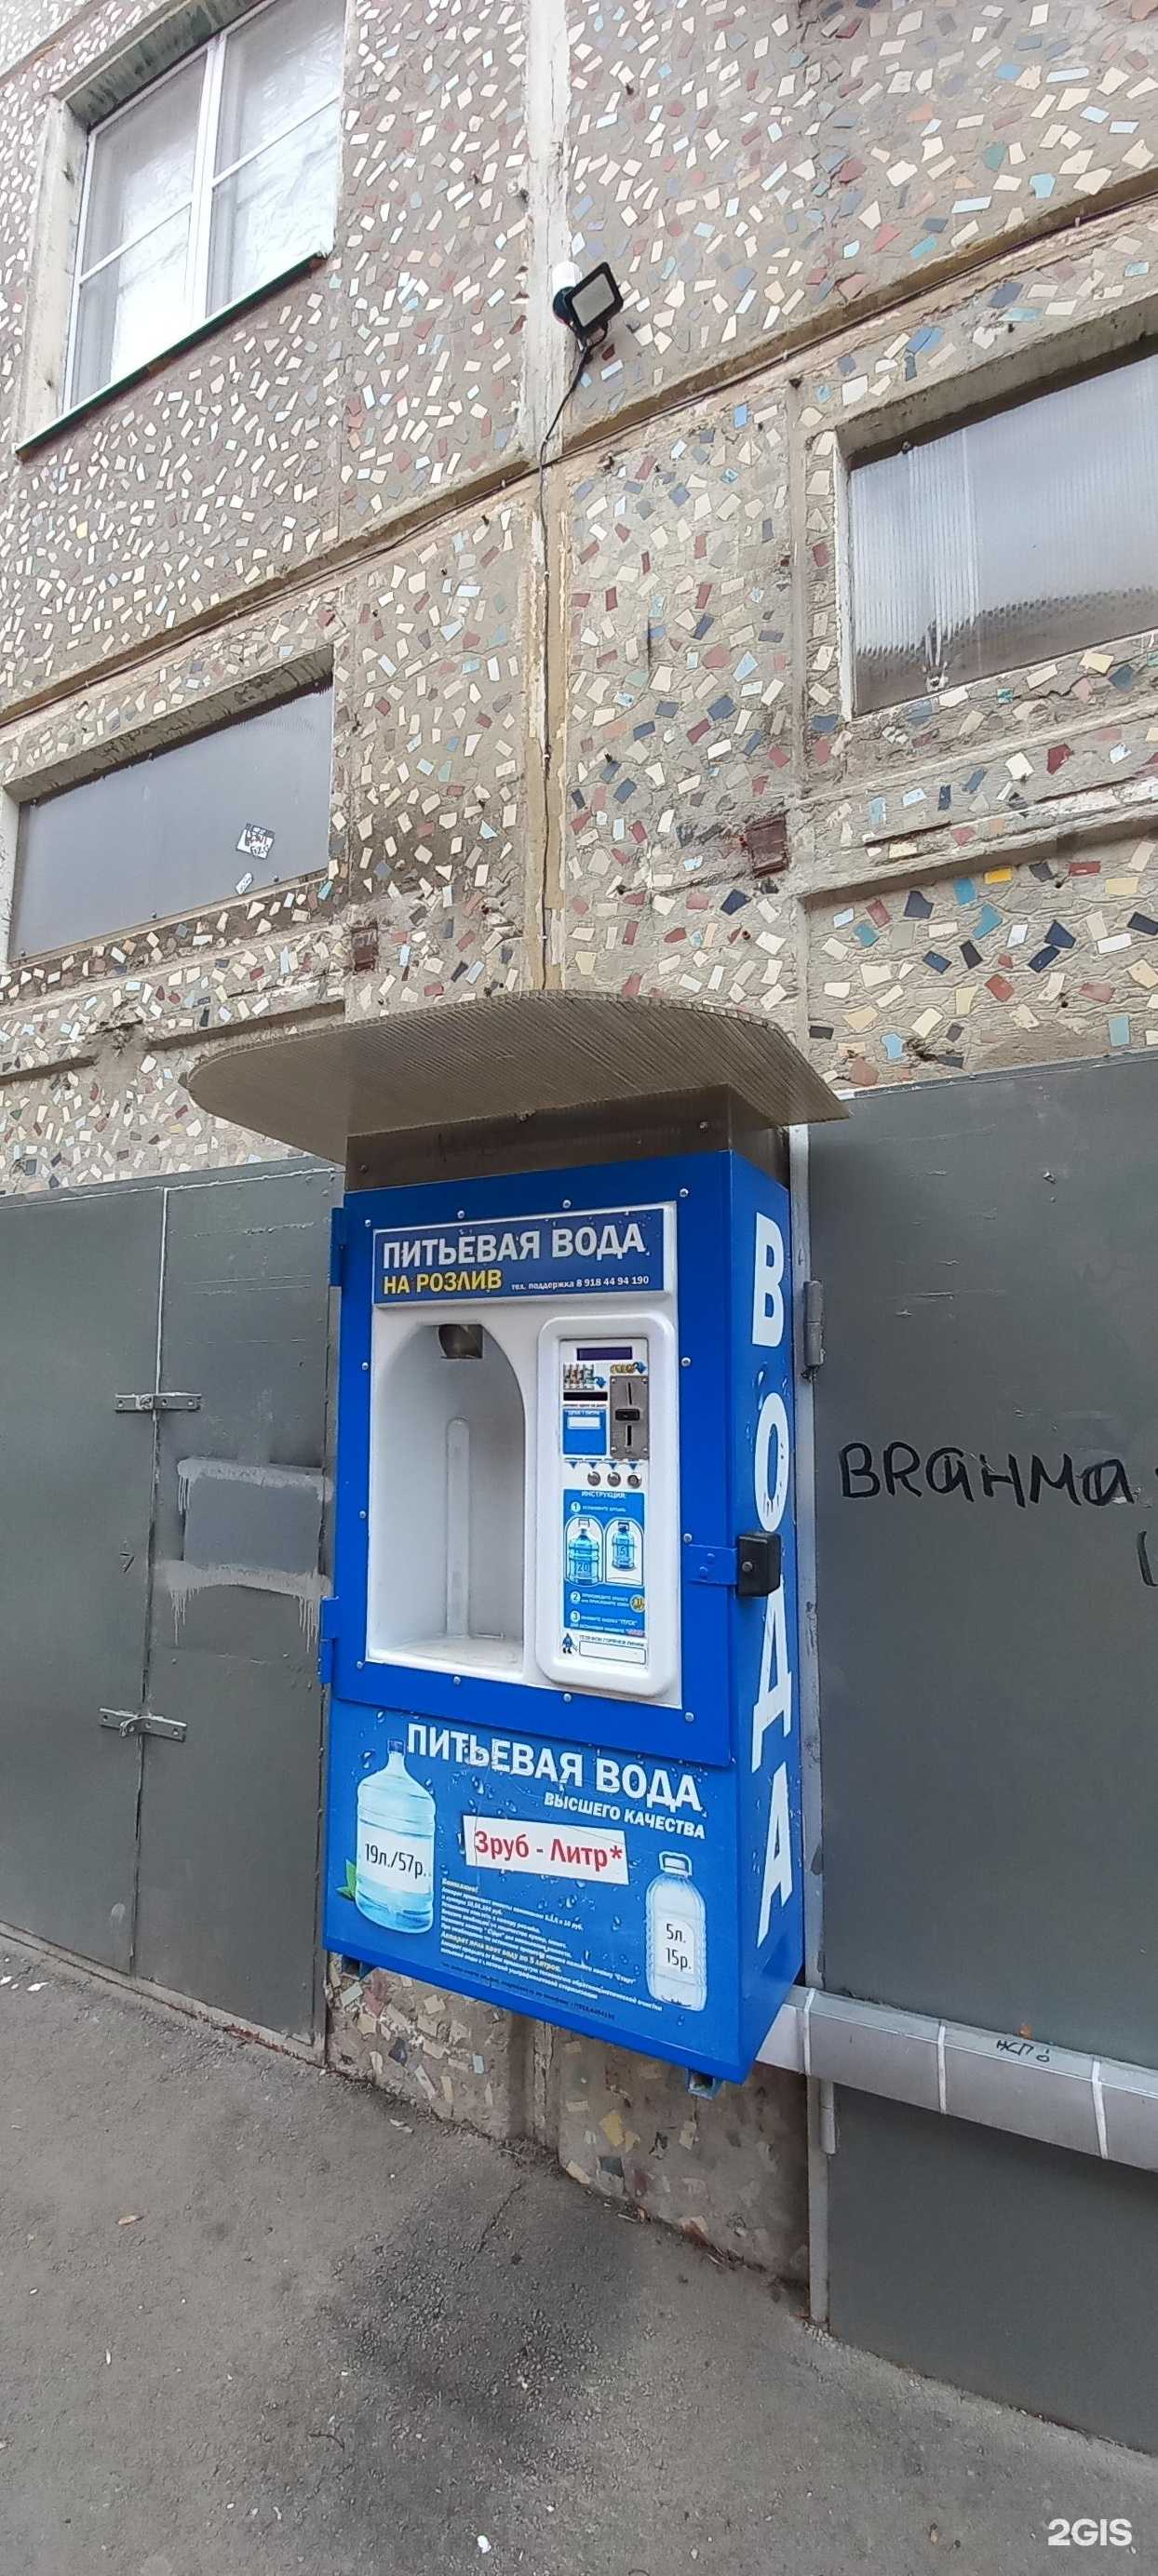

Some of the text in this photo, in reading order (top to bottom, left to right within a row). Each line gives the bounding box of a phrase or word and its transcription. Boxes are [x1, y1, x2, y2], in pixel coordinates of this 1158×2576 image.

[383, 1223, 646, 1269] ПИТЬЕВАЯ ВОДА
[383, 1268, 503, 1295] НА РОЗЛИВ
[575, 1279, 583, 1287] 8
[584, 1277, 602, 1287] 918
[603, 1277, 616, 1287] 44
[617, 1276, 630, 1286] 94
[631, 1275, 650, 1285] 190
[408, 1723, 703, 1813] ПИТЬЕВАЯ ВОДА
[545, 1791, 706, 1840] ВЫСШЕГО КАЧЕСТВА
[666, 1923, 686, 1943] 5л.
[666, 1947, 692, 1972] 15р.
